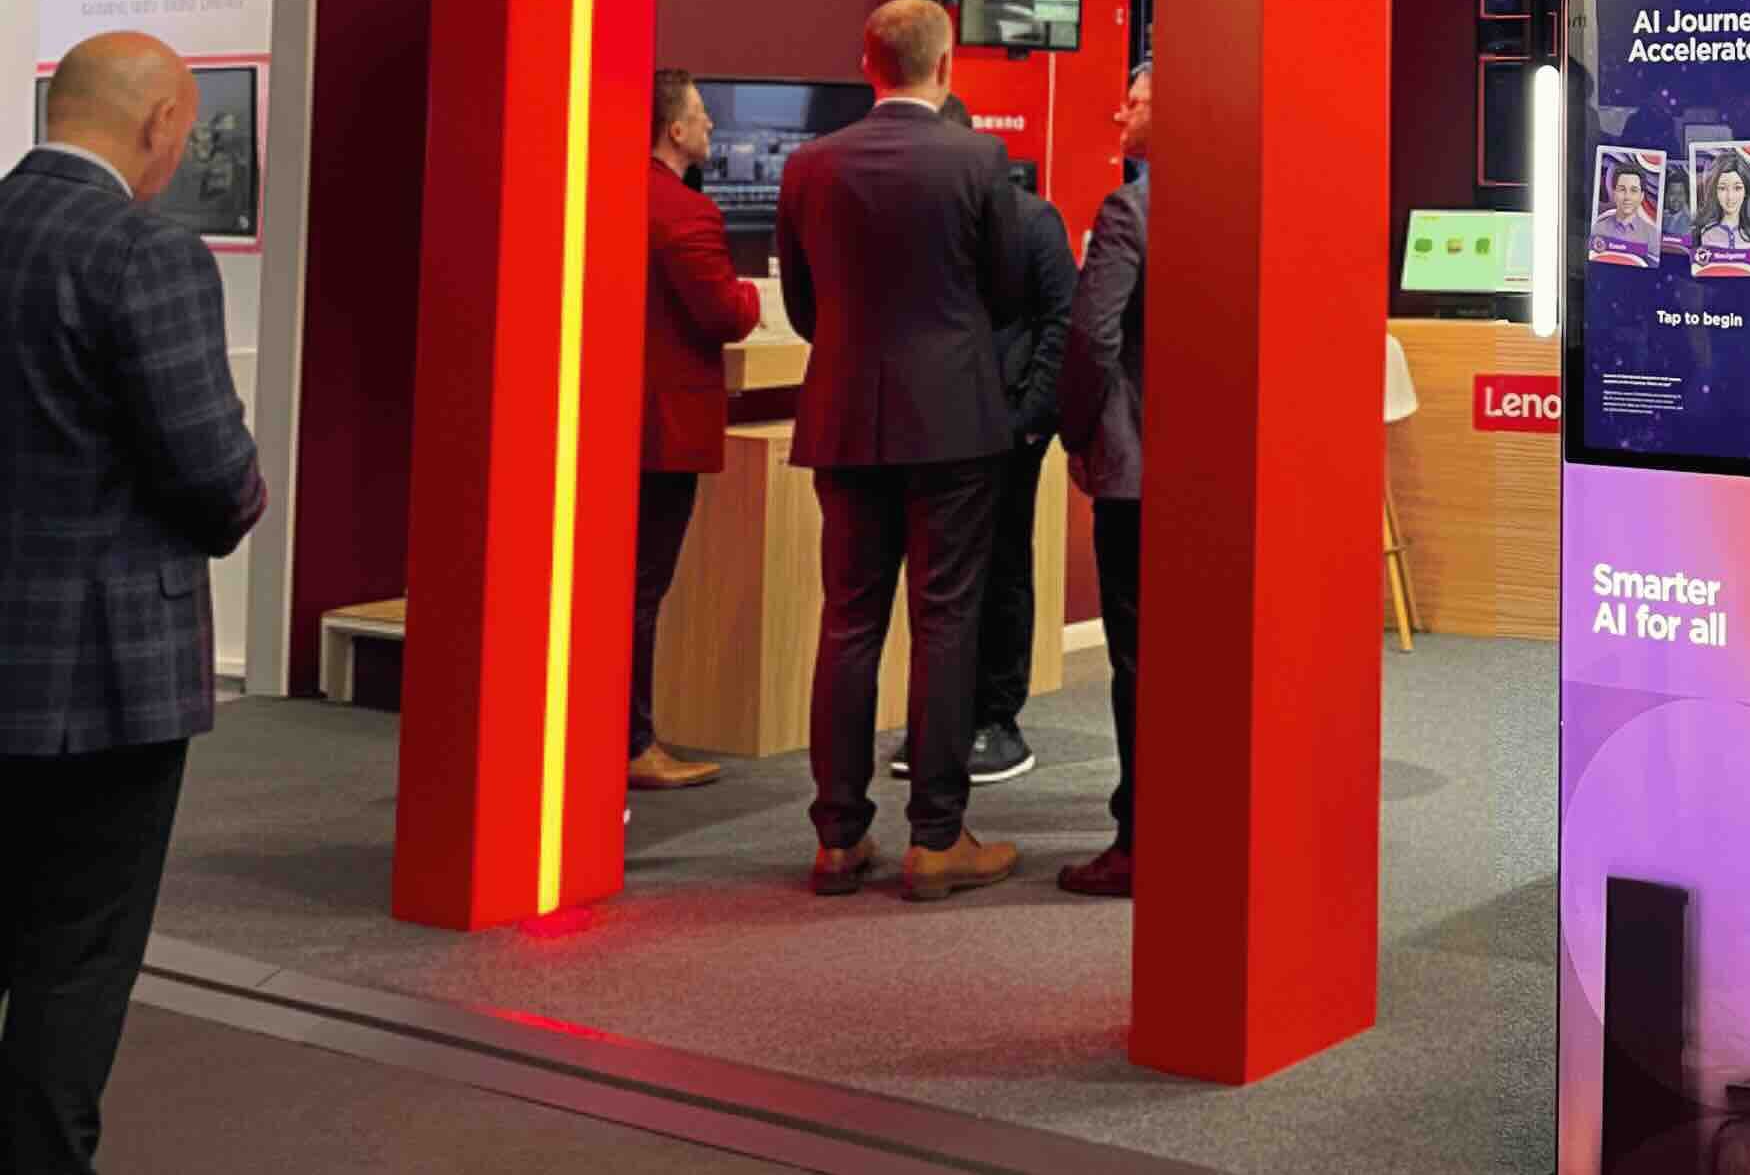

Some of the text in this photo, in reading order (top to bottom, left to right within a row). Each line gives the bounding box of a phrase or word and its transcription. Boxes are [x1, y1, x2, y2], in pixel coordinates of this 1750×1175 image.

[1632, 10, 1660, 33] AI
[1656, 310, 1743, 328] Tap to begin
[1484, 386, 1562, 419] Leno
[1593, 563, 1721, 605] Smarter
[1593, 602, 1727, 646] AI for all
